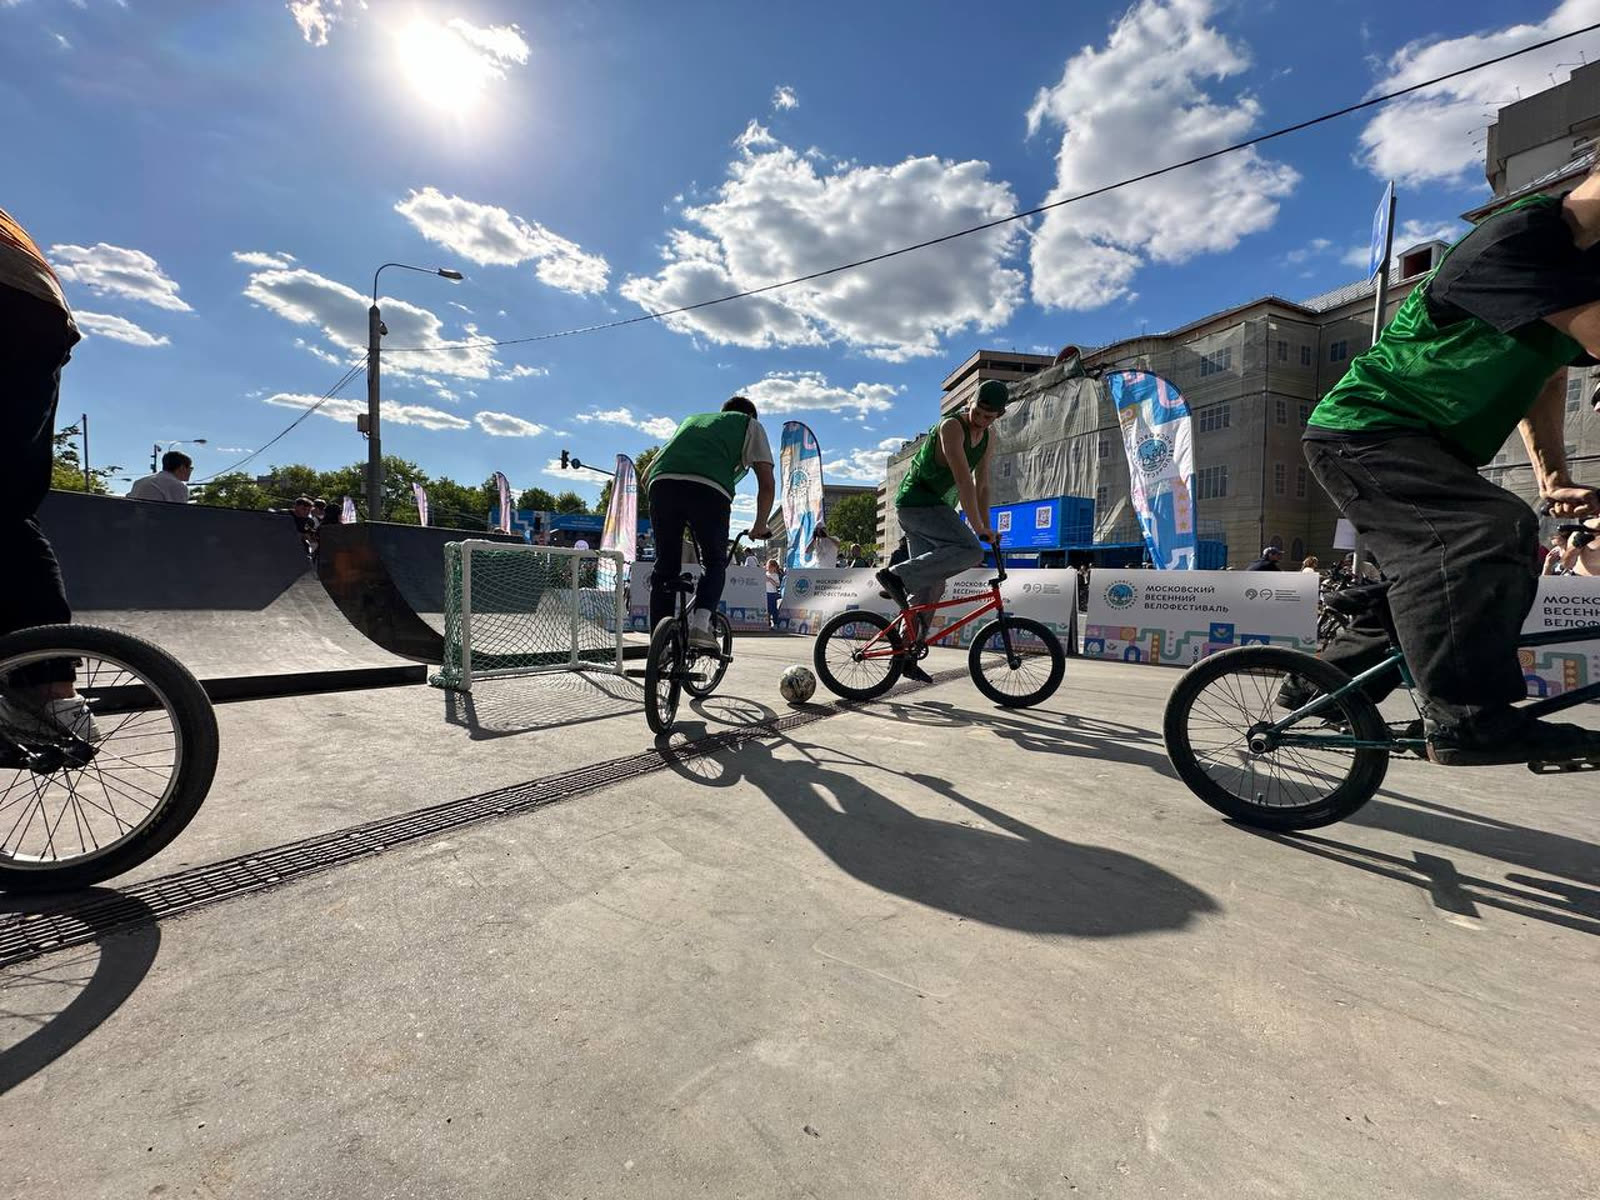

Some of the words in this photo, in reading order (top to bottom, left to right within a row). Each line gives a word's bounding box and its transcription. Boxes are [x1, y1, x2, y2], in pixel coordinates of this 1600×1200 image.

[1145, 585, 1215, 593] МОСКОВСКИЙ
[1144, 593, 1196, 602] ВЕСЕННИЙ
[1144, 602, 1229, 613] ВЕЛОФЕСТИВАЛЬ
